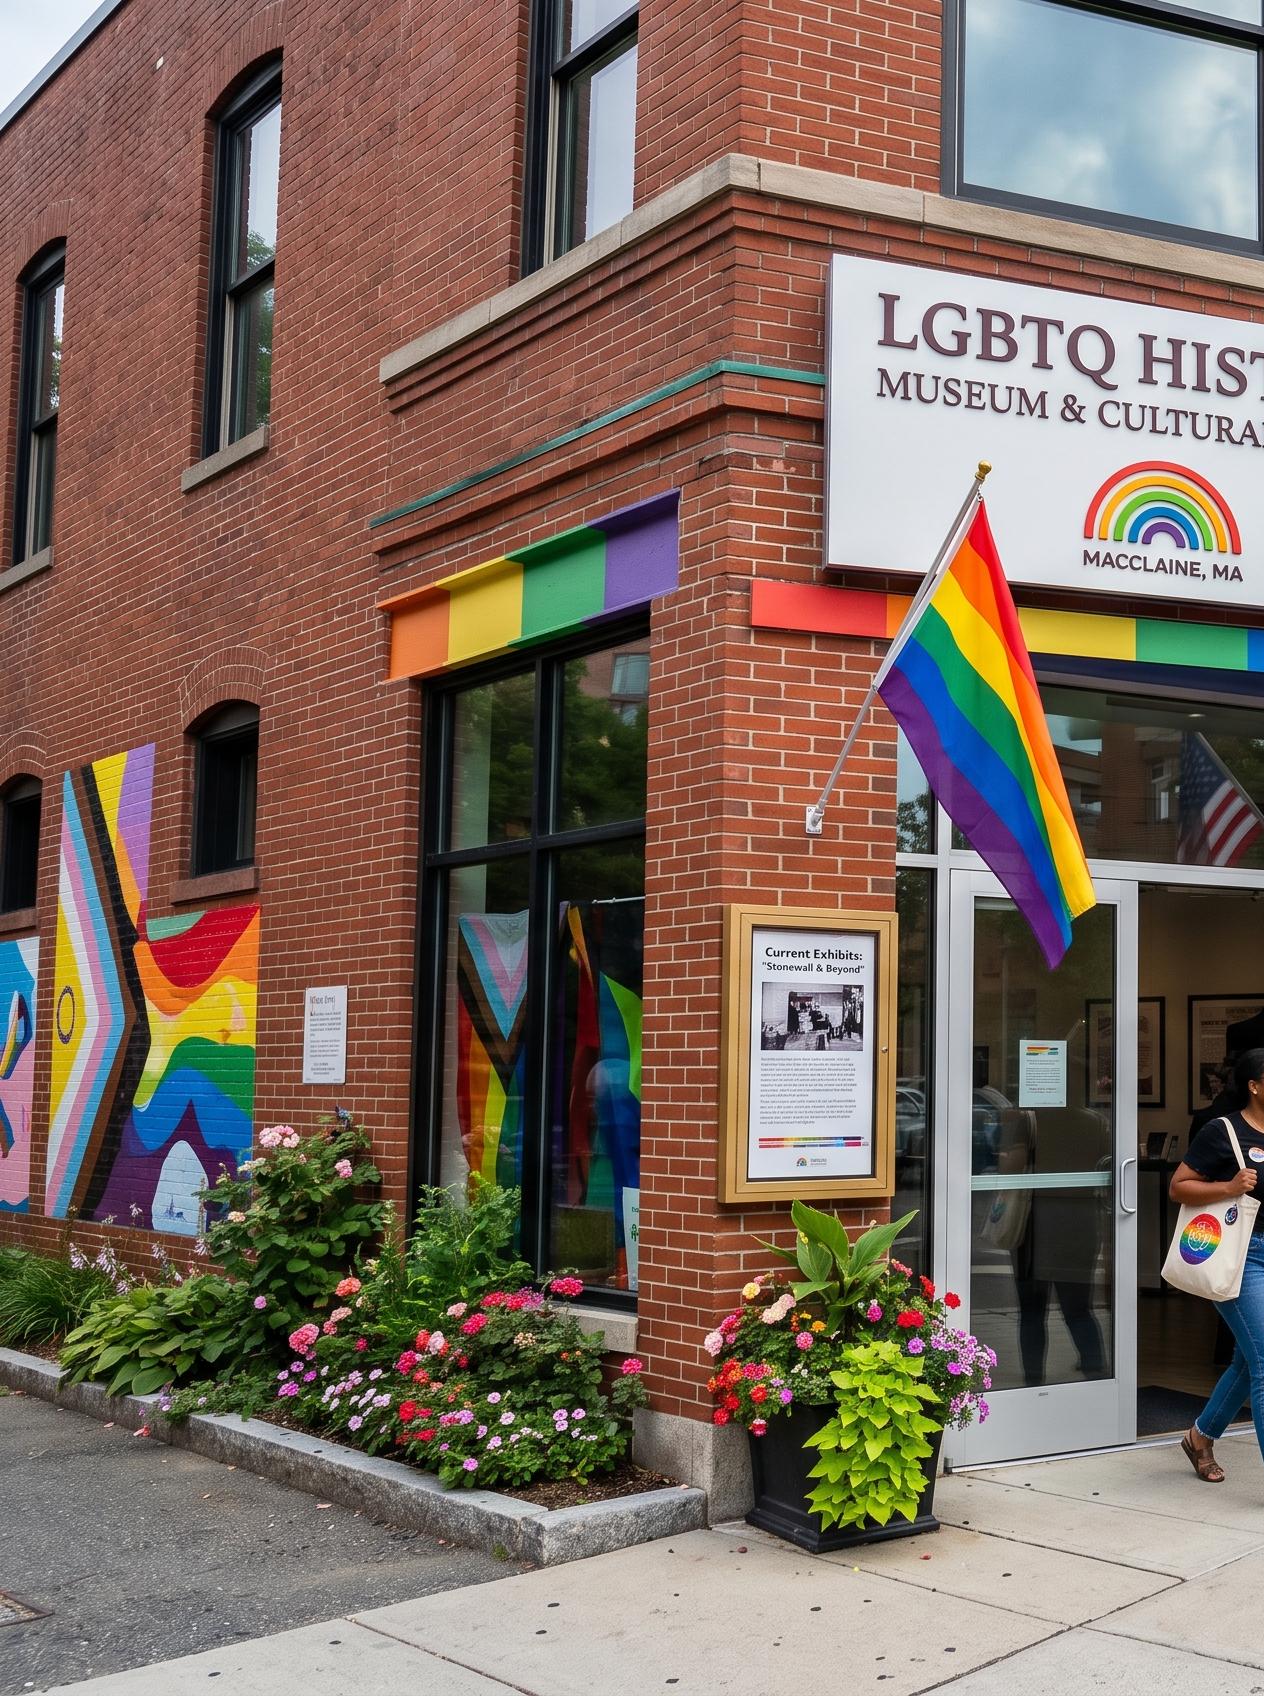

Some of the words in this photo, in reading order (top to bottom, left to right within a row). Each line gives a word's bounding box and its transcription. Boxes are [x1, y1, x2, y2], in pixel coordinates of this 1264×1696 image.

[877, 291, 1119, 391] LGBTQ
[876, 367, 1049, 420] MUSEUM
[1060, 393, 1087, 425] &
[1083, 549, 1207, 582] MACCLAINE,
[1212, 563, 1244, 583] MA
[762, 961, 814, 972] "Stonewall
[815, 963, 824, 973] &
[826, 964, 865, 976] Beyond"
[765, 946, 811, 959] Current
[813, 948, 863, 961] Exhibits:
